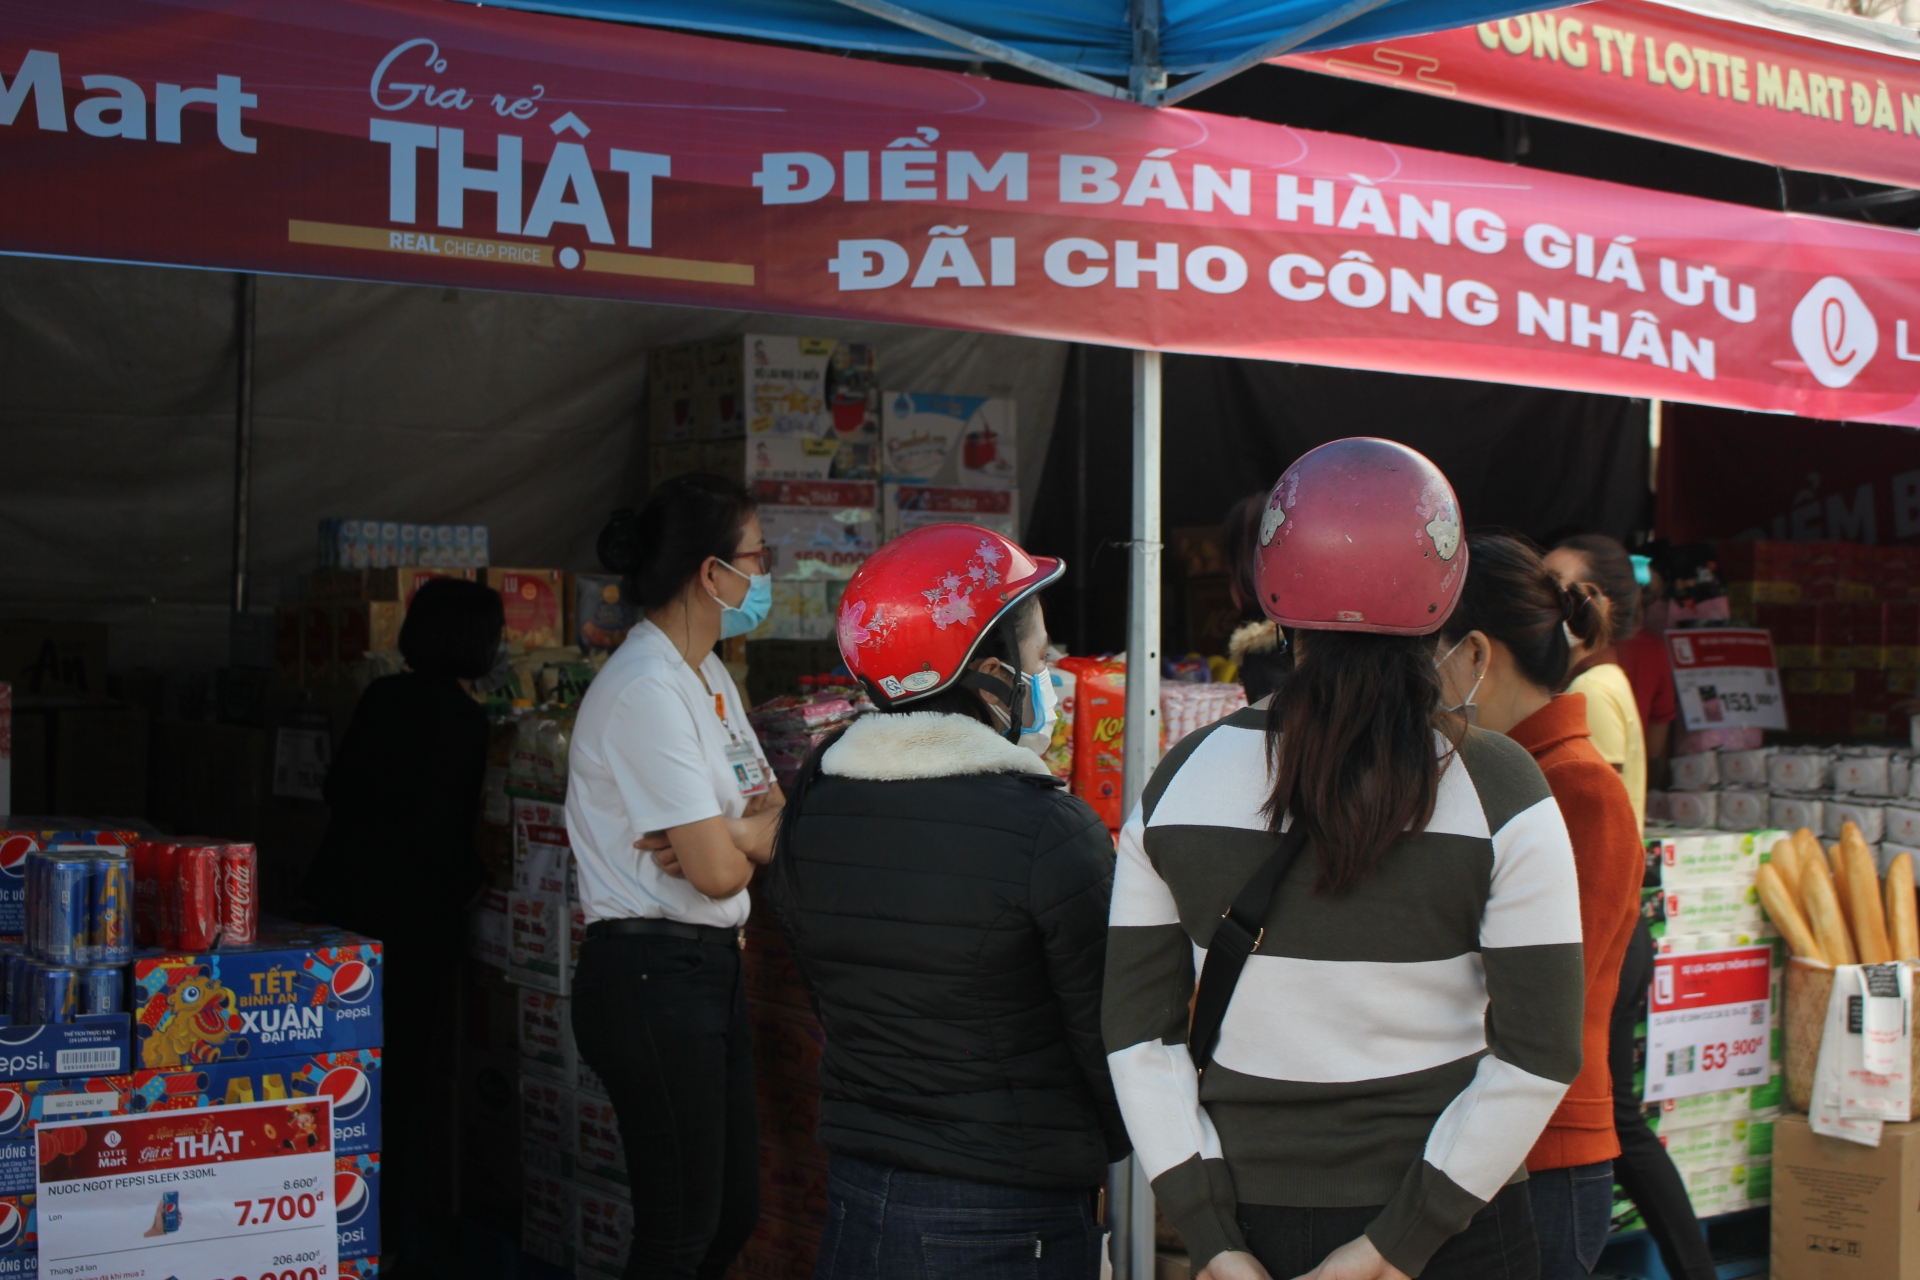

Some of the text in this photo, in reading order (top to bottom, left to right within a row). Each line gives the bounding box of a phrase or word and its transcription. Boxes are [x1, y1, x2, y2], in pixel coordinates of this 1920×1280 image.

[1593, 26, 1634, 78] TY
[1645, 34, 1750, 102] LOTTE
[1757, 62, 1844, 122] MART
[1851, 79, 1897, 132] ĐÀ
[0, 49, 257, 153] Mart
[370, 111, 671, 270] THẬT
[752, 126, 1757, 324] ĐIỂM BÁN HÀNG GIÁ ƯU
[389, 231, 541, 264] REAL CHEAP PRICE
[828, 225, 1716, 380] ĐÃI CHO CÔNG NHÂN
[1733, 472, 1879, 546] IỂM
[249, 964, 297, 995] TẾT
[240, 993, 298, 1008] BÌNH AN
[336, 1005, 371, 1021] pepsi
[240, 1003, 324, 1035] XUÂN
[260, 1030, 285, 1045] ĐẠI
[0, 1050, 44, 1076] epsi
[174, 1126, 244, 1161] THẬT
[334, 1122, 366, 1142] epsi
[98, 1149, 128, 1158] LOTTE
[98, 1156, 128, 1168] Mart
[48, 1168, 217, 1196] NUOC NGOT PEPSI SLEEK 330ML
[48, 1214, 63, 1222] Lon
[234, 1191, 325, 1227] 7.700đ
[49, 1263, 98, 1277] Thùng 24 lon
[123, 1271, 140, 1279] mua
[140, 1269, 145, 1277] 2
